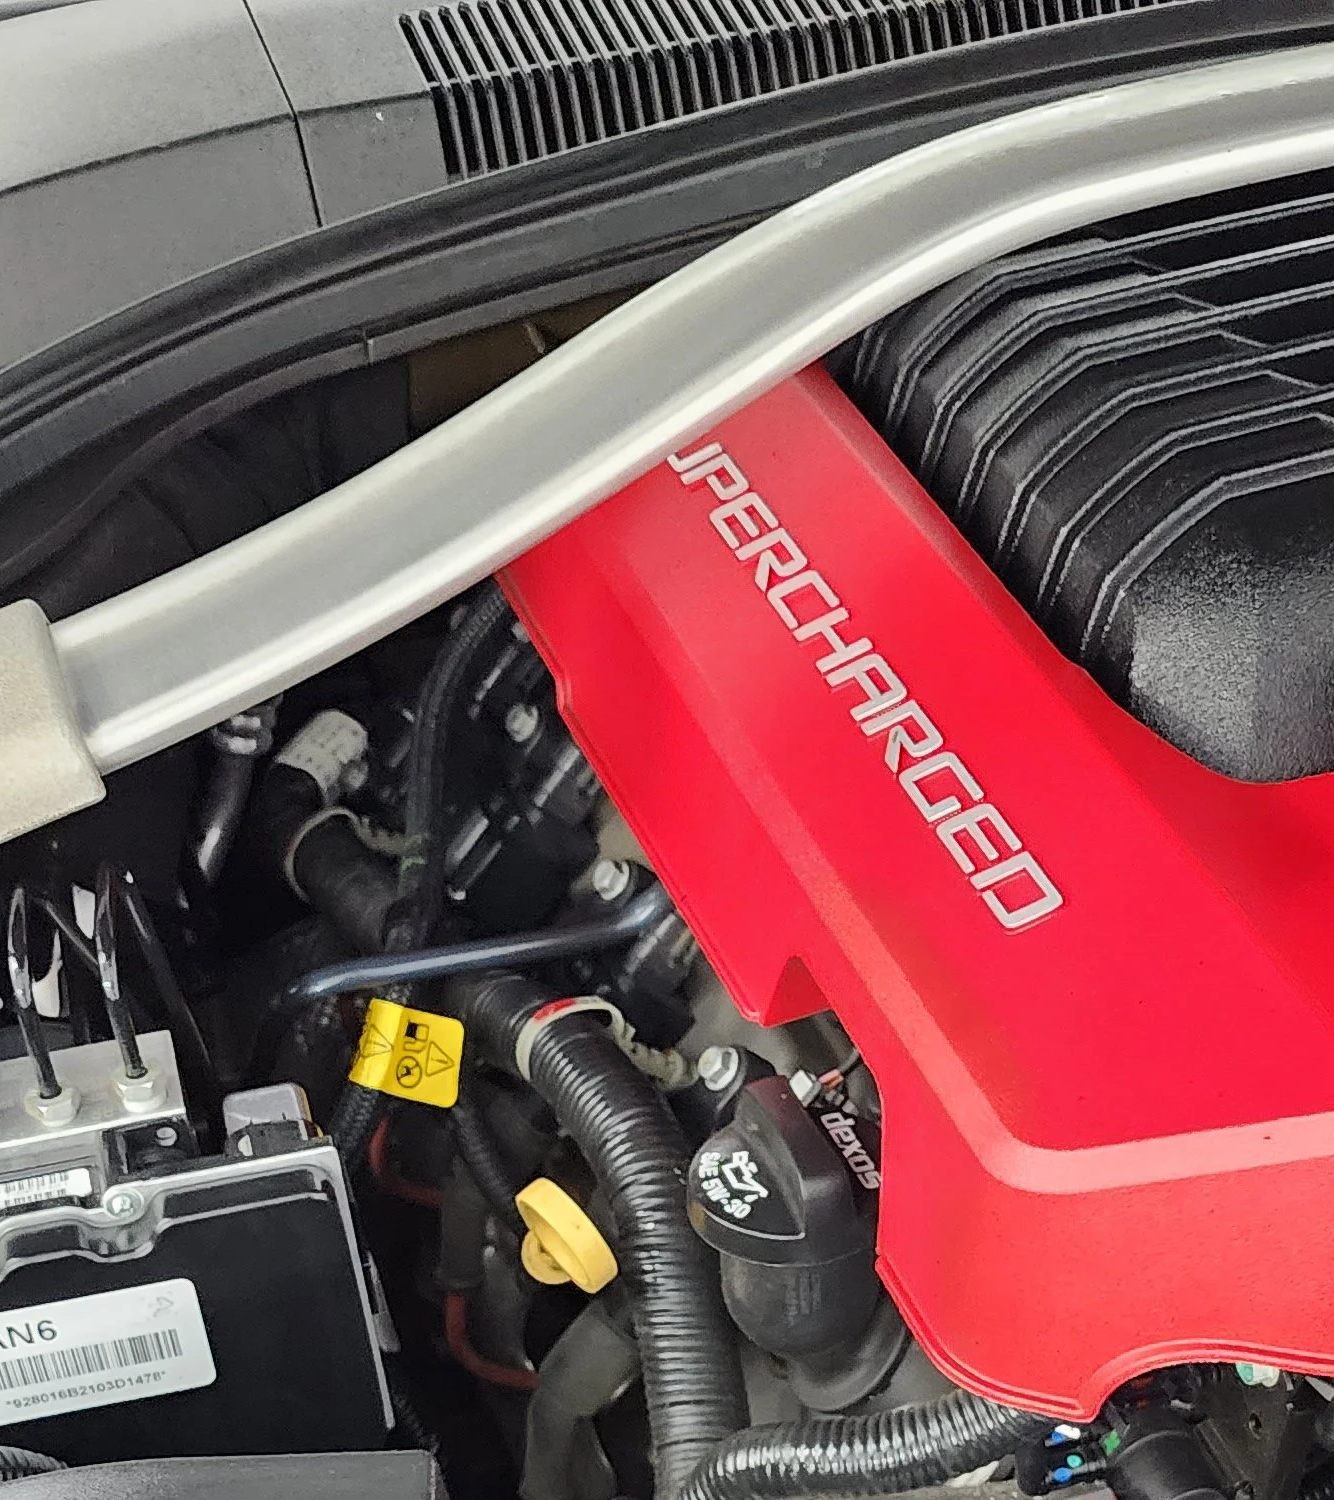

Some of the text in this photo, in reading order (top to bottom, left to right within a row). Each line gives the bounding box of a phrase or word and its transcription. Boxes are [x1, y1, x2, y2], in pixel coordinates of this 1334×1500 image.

[666, 442, 1064, 932] UPERCHARGED
[698, 1151, 752, 1220] SAE 5W-30
[820, 1111, 882, 1190] dexos
